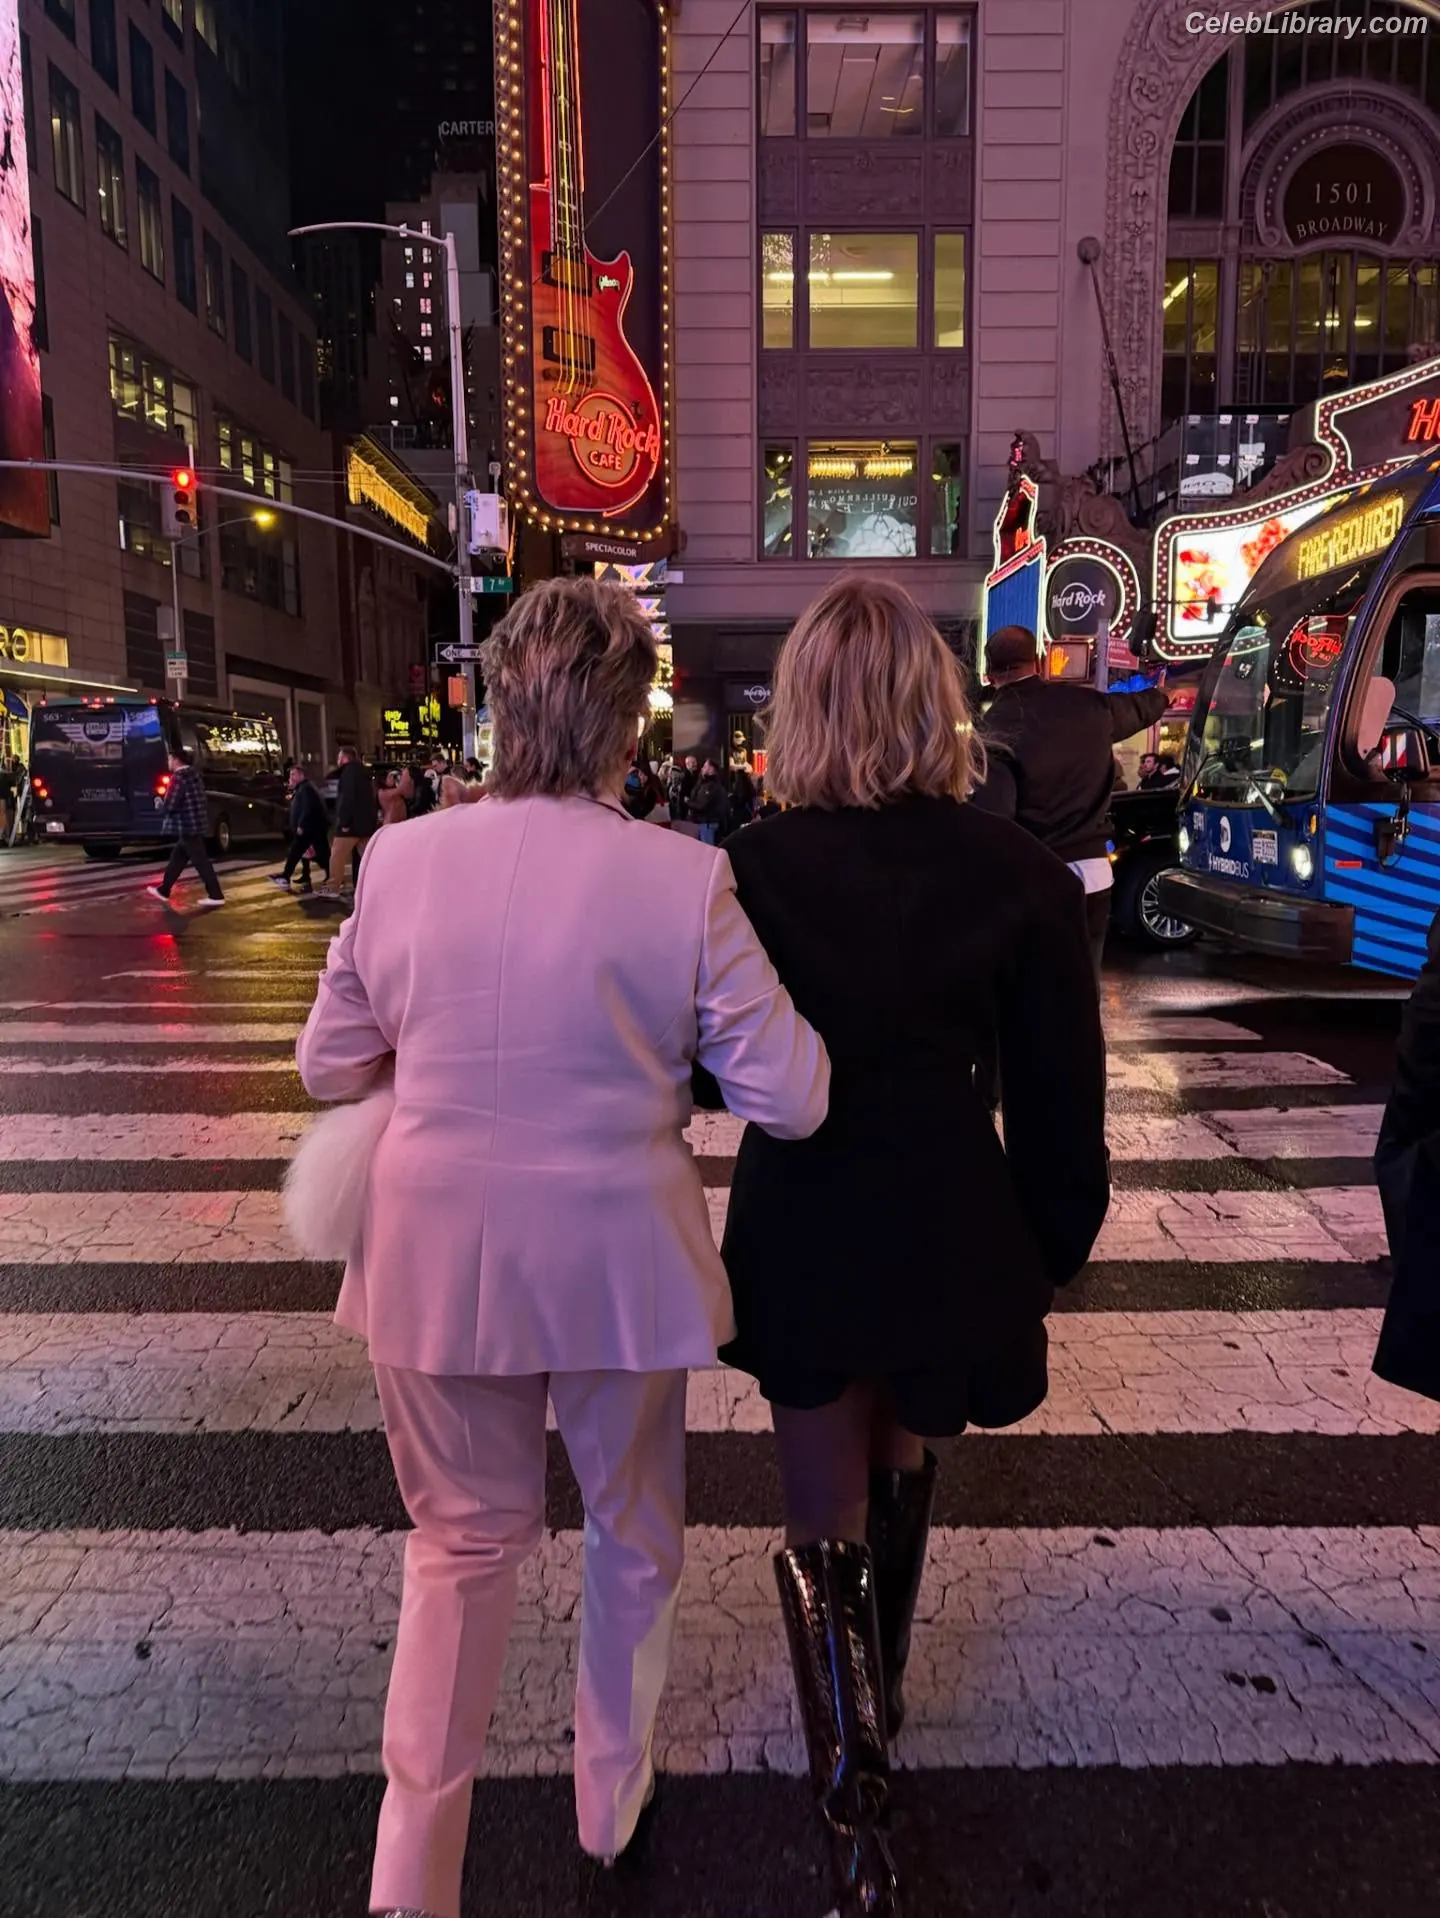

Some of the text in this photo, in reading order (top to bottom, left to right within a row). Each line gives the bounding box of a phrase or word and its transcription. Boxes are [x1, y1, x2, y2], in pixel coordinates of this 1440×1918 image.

[441, 120, 494, 136] CARTER
[1315, 182, 1372, 204] 1501
[1296, 216, 1388, 238] BROADWAY
[545, 398, 660, 462] Hard Rock
[589, 451, 622, 470] CAFE
[1298, 496, 1403, 580] FARE REQUIRED
[585, 542, 637, 557] SPECTACOLOR
[490, 579, 495, 591] 7
[1052, 590, 1106, 609] Hard Rock
[445, 648, 463, 658] ONE
